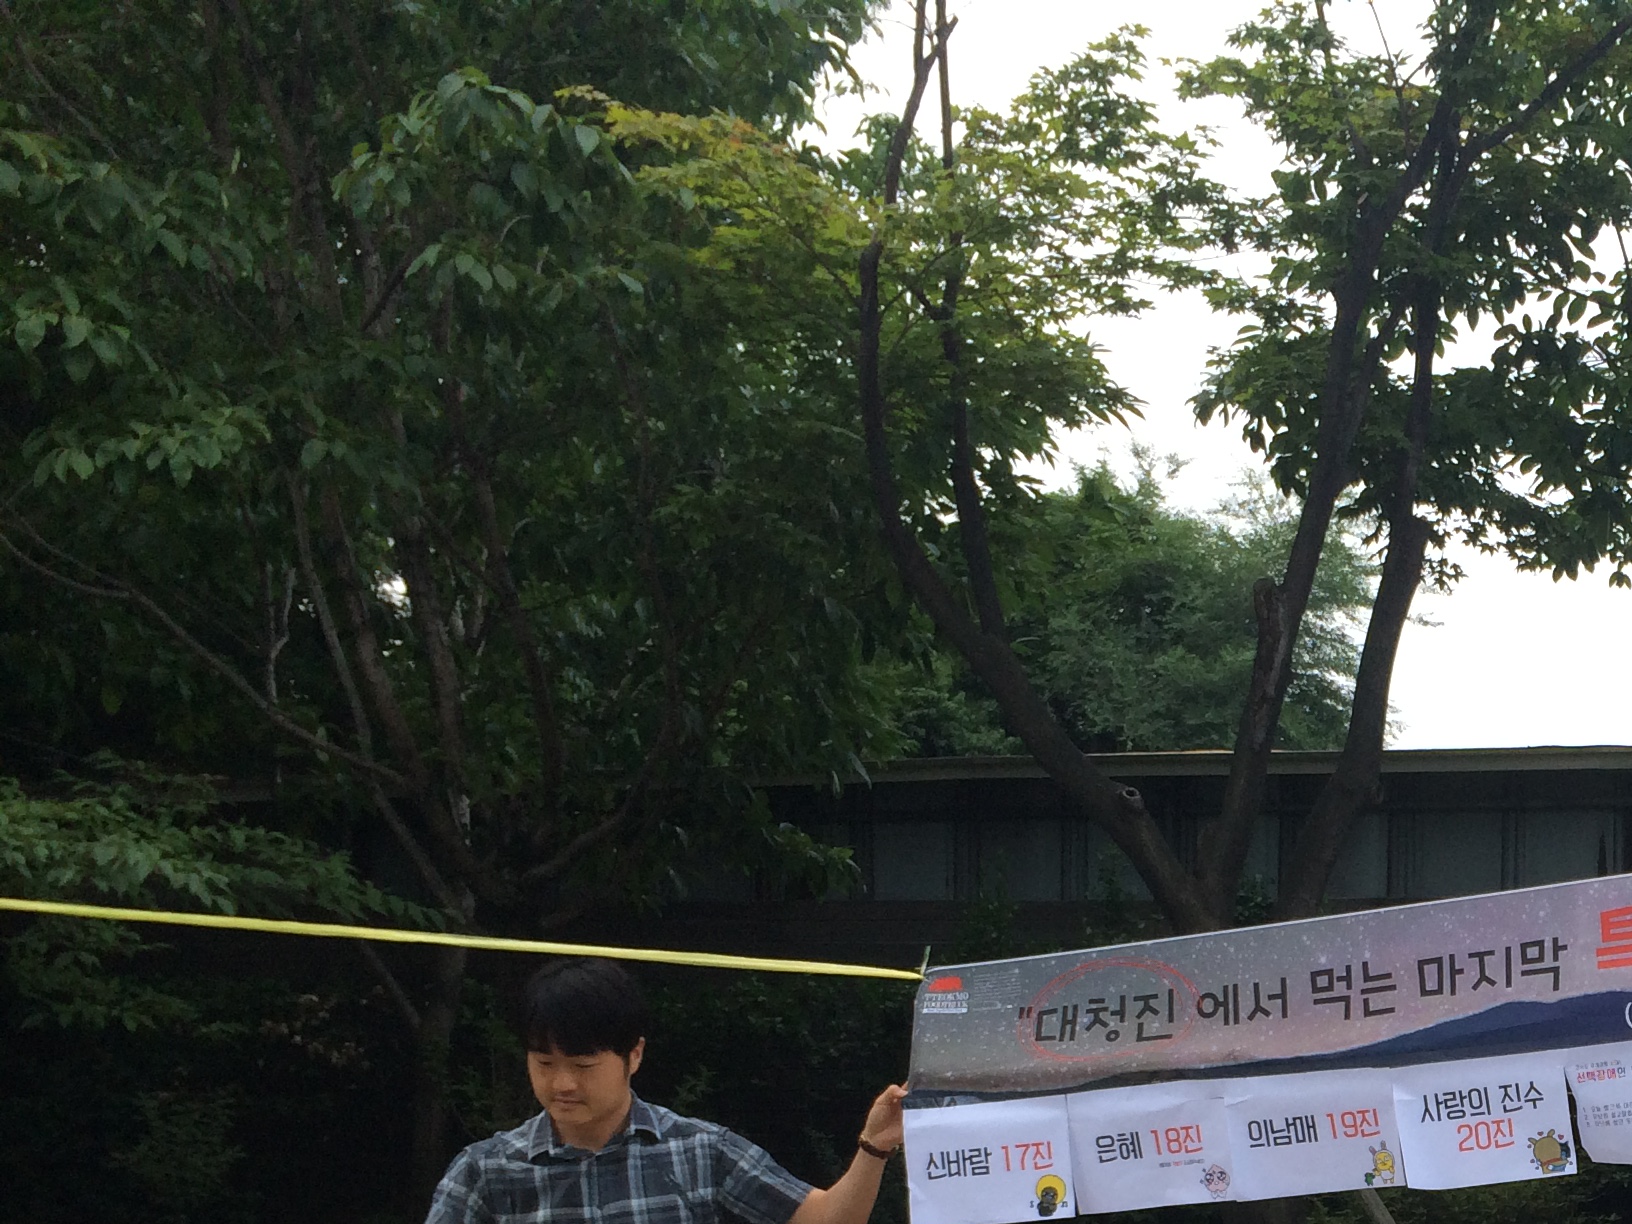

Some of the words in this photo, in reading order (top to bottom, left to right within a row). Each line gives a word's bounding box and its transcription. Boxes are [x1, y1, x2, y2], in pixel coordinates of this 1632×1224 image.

[1018, 988, 1174, 1042] "대청진
[1196, 977, 1288, 1026] 에서
[1310, 961, 1397, 1021] 먹는
[1417, 937, 1569, 998] 마지막
[1420, 1087, 1491, 1123] 사랑의
[1498, 1081, 1544, 1113] 진수
[1095, 1131, 1144, 1163] 은혜
[1150, 1124, 1204, 1155] 18진
[1247, 1115, 1319, 1148] 의남매
[1325, 1108, 1381, 1139] 19진
[1457, 1118, 1516, 1152] 20진
[926, 1147, 992, 1180] 신바람
[1001, 1141, 1054, 1172] 17진
